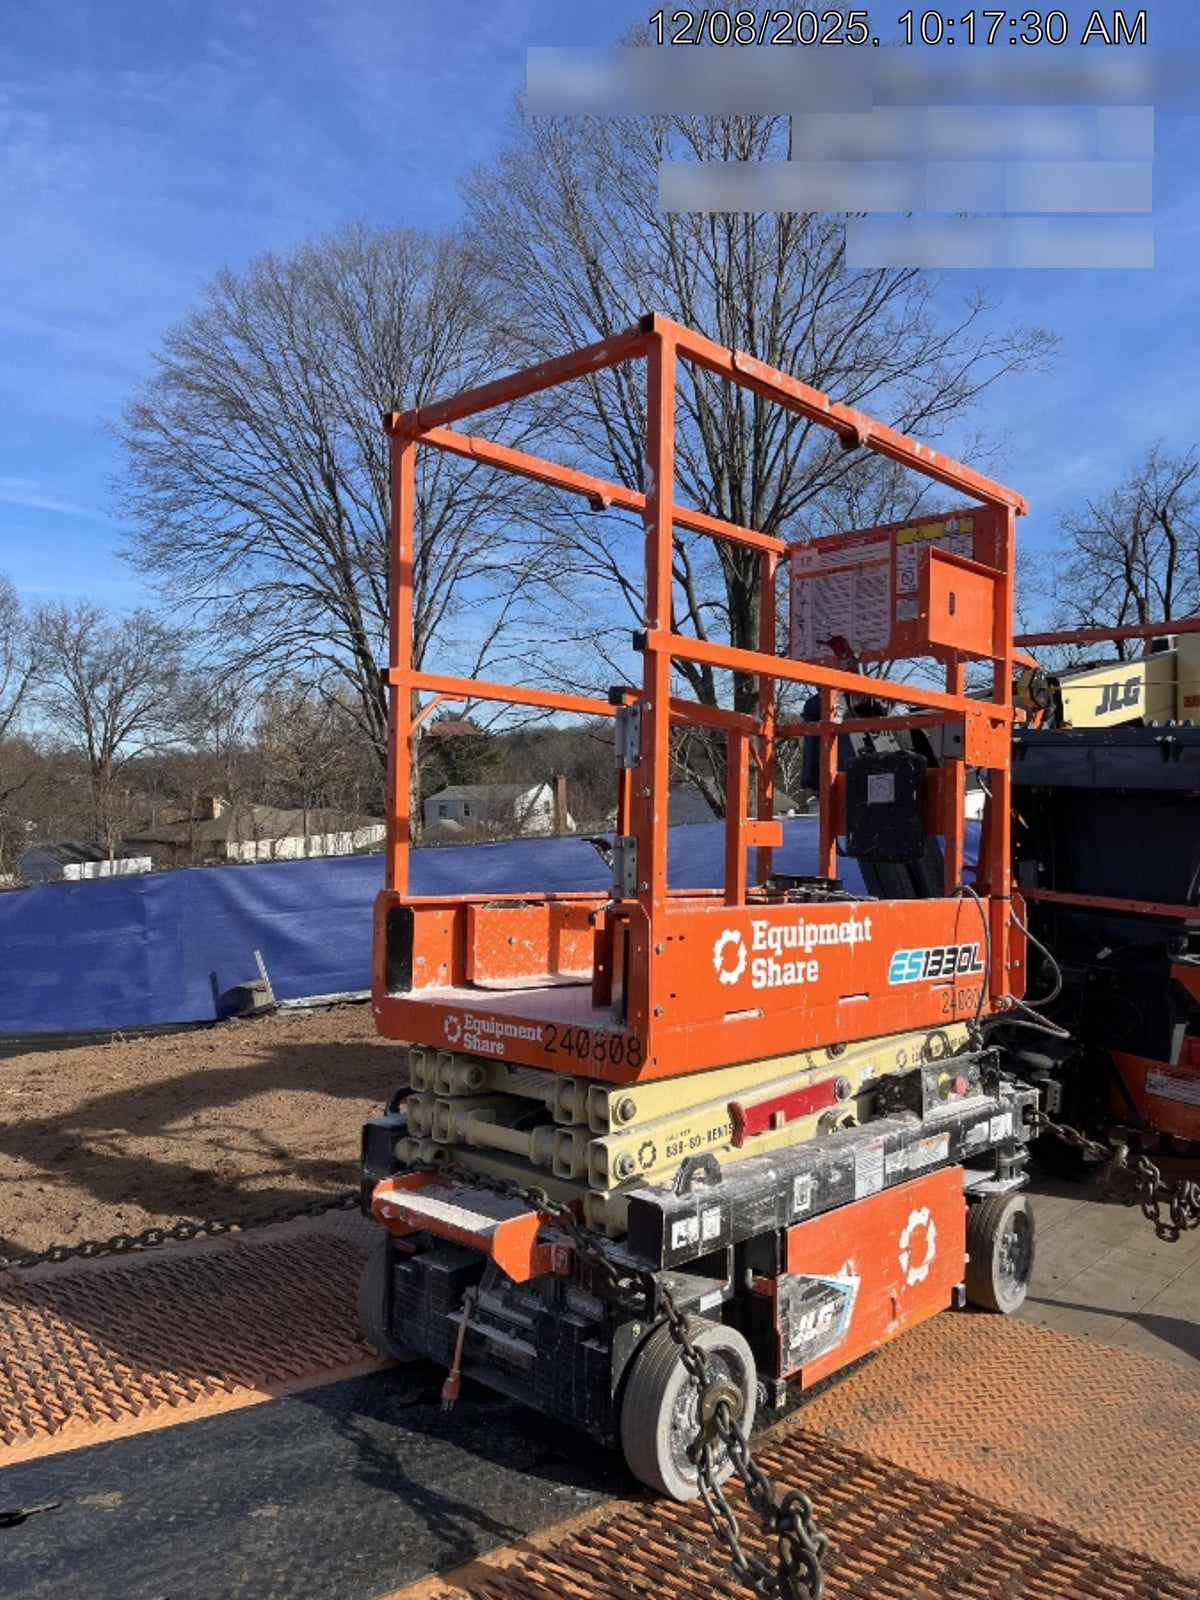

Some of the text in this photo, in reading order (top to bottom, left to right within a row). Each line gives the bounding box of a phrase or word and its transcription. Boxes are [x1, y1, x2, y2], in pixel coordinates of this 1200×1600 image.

[1095, 675, 1142, 717] JLG
[751, 916, 872, 956] Equipment
[751, 957, 819, 989] Share
[889, 944, 984, 984] ES1330L
[463, 1013, 543, 1042] Equipment
[463, 1033, 505, 1055] Share
[543, 1023, 643, 1068] 240808
